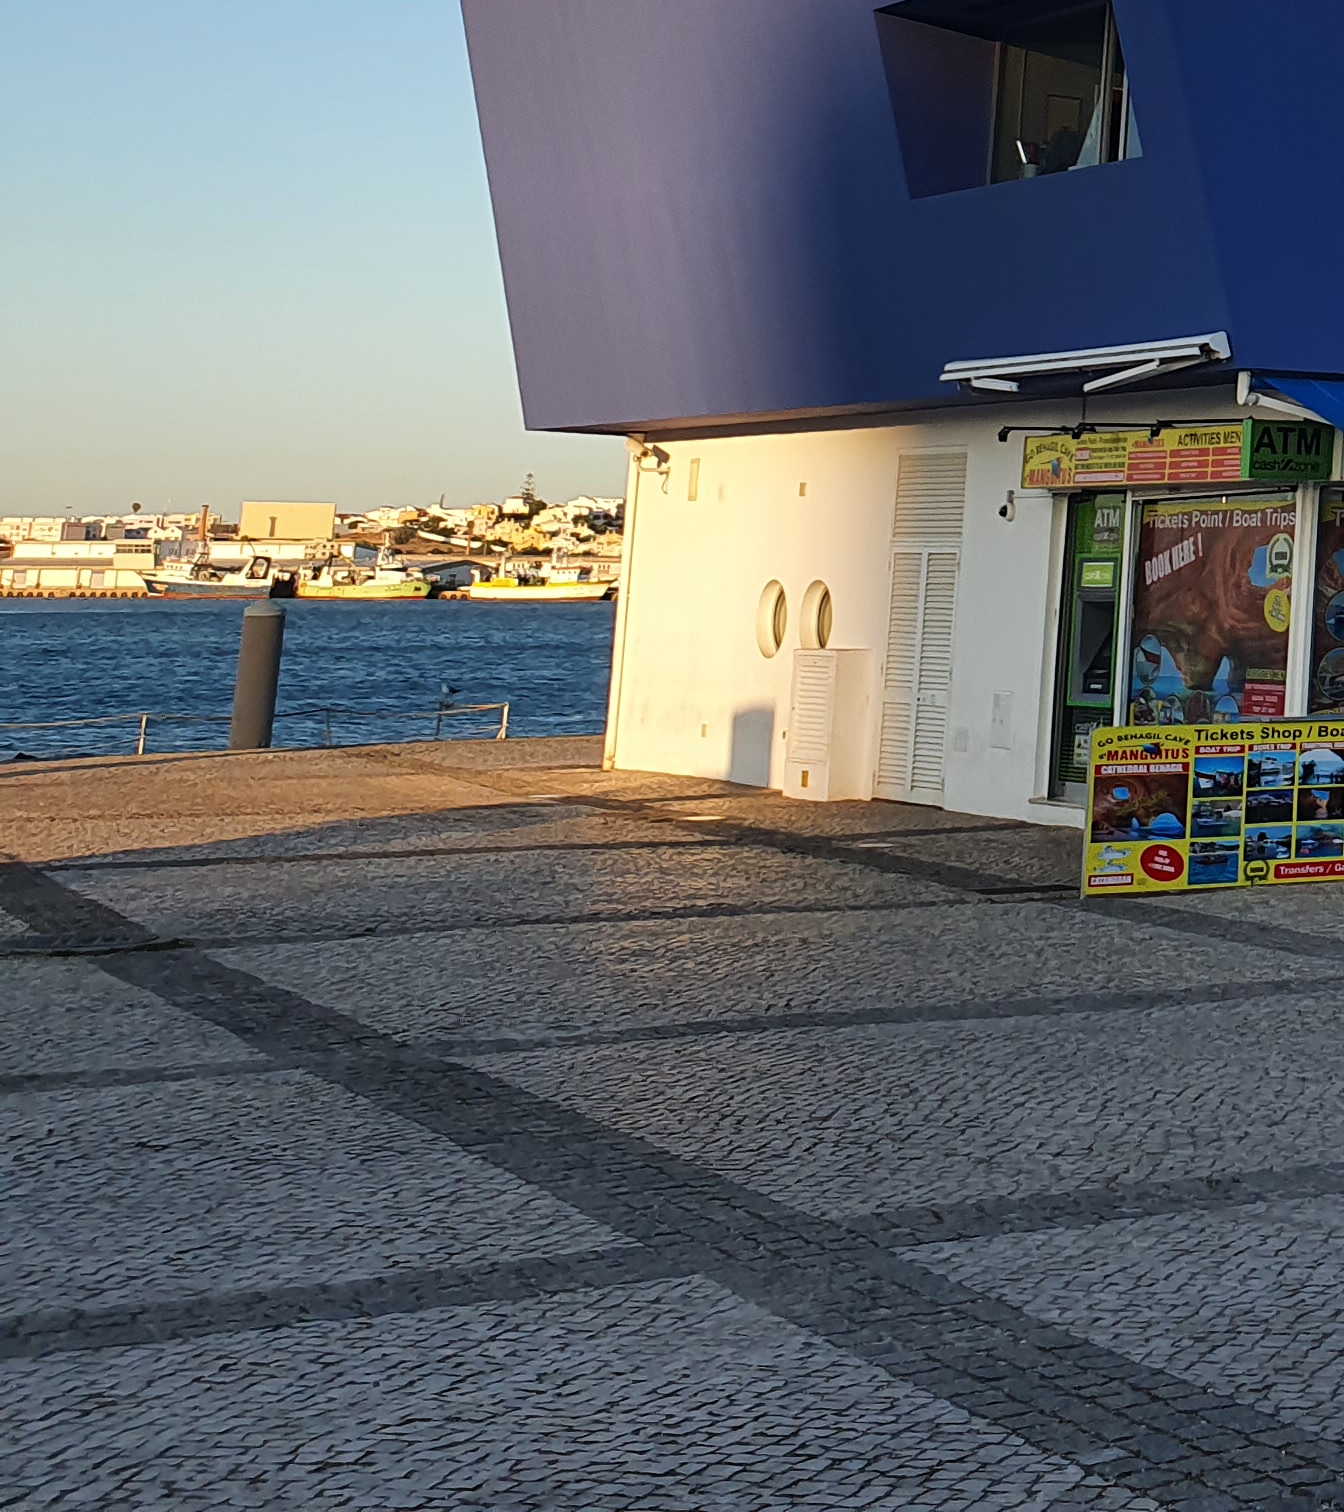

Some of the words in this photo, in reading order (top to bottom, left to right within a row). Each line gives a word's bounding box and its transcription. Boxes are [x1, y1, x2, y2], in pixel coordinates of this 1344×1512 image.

[1177, 432, 1221, 447] ACTIVITIES
[1223, 430, 1242, 444] MEN
[1253, 425, 1321, 456] ATM
[1094, 508, 1120, 528] ATM
[1150, 509, 1189, 529] Tickets
[1191, 510, 1224, 528] Point
[1232, 510, 1262, 528] Boat
[1265, 508, 1297, 531] Trips
[1144, 552, 1172, 586] BOOK
[1171, 536, 1196, 571] HERE
[1097, 737, 1114, 748] GO
[1117, 732, 1162, 743] BENAGIL
[1164, 733, 1192, 746] CAVE
[1194, 727, 1255, 743] Tickets
[1260, 725, 1303, 742] Shop
[1279, 864, 1324, 875] Transfers
